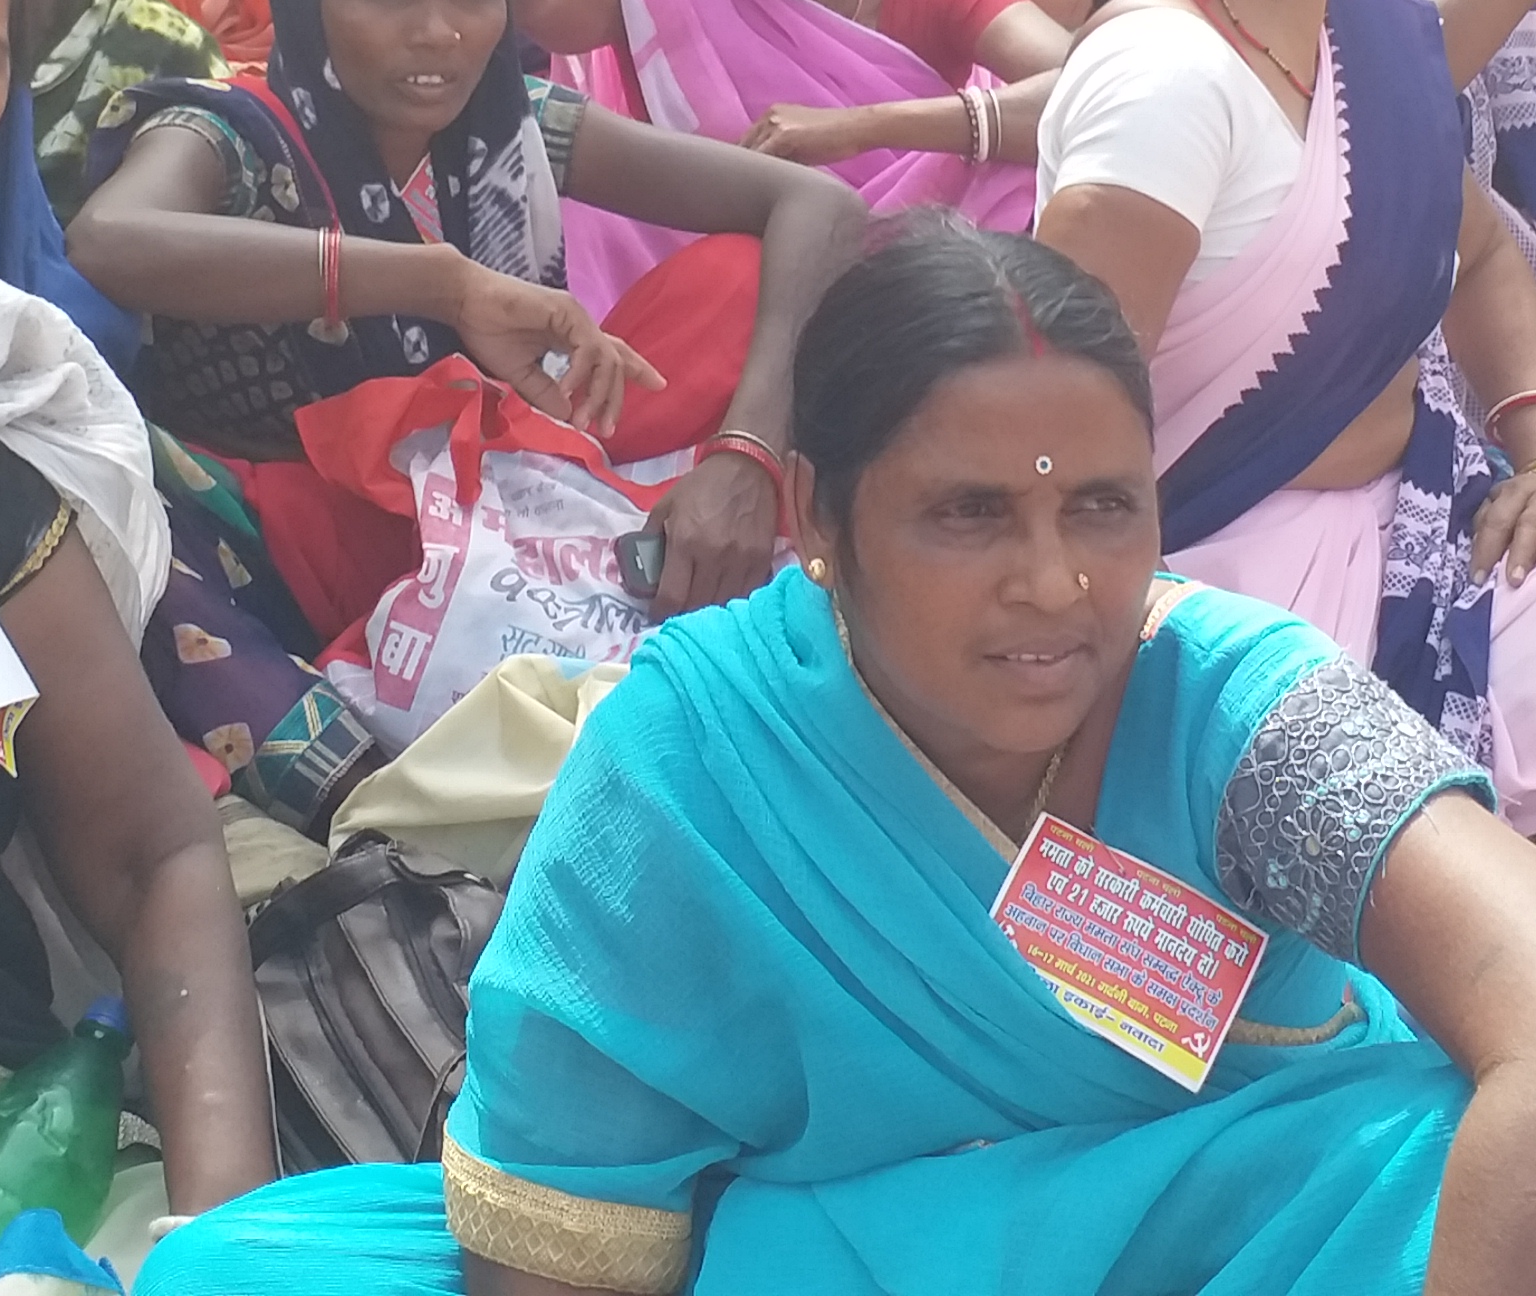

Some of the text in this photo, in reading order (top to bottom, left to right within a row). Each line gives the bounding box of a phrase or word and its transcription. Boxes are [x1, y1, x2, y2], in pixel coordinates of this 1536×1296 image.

[1040, 838, 1074, 868] ममता
[1074, 855, 1095, 879] को
[1094, 867, 1140, 903] सरकारी
[1139, 890, 1187, 929] कर्मचारी
[1224, 939, 1249, 967] करो
[1047, 871, 1072, 895] एवं
[1067, 883, 1089, 906] 21
[1089, 894, 1124, 924] हजार
[1154, 928, 1198, 966] मानदेय
[1050, 926, 1067, 944] पर
[1066, 932, 1103, 964] विधान
[1104, 955, 1130, 979] सभा
[1131, 970, 1147, 986] के
[1147, 982, 1179, 1007] समक्ष
[1178, 999, 1218, 1030] प्रदर्शन
[1055, 904, 1084, 928] राज्य
[1085, 920, 1119, 947] ममता
[1207, 989, 1222, 1005] के
[1076, 970, 1096, 987] 2021
[1153, 1012, 1178, 1033] पटना
[1120, 1022, 1164, 1052] नवादा
